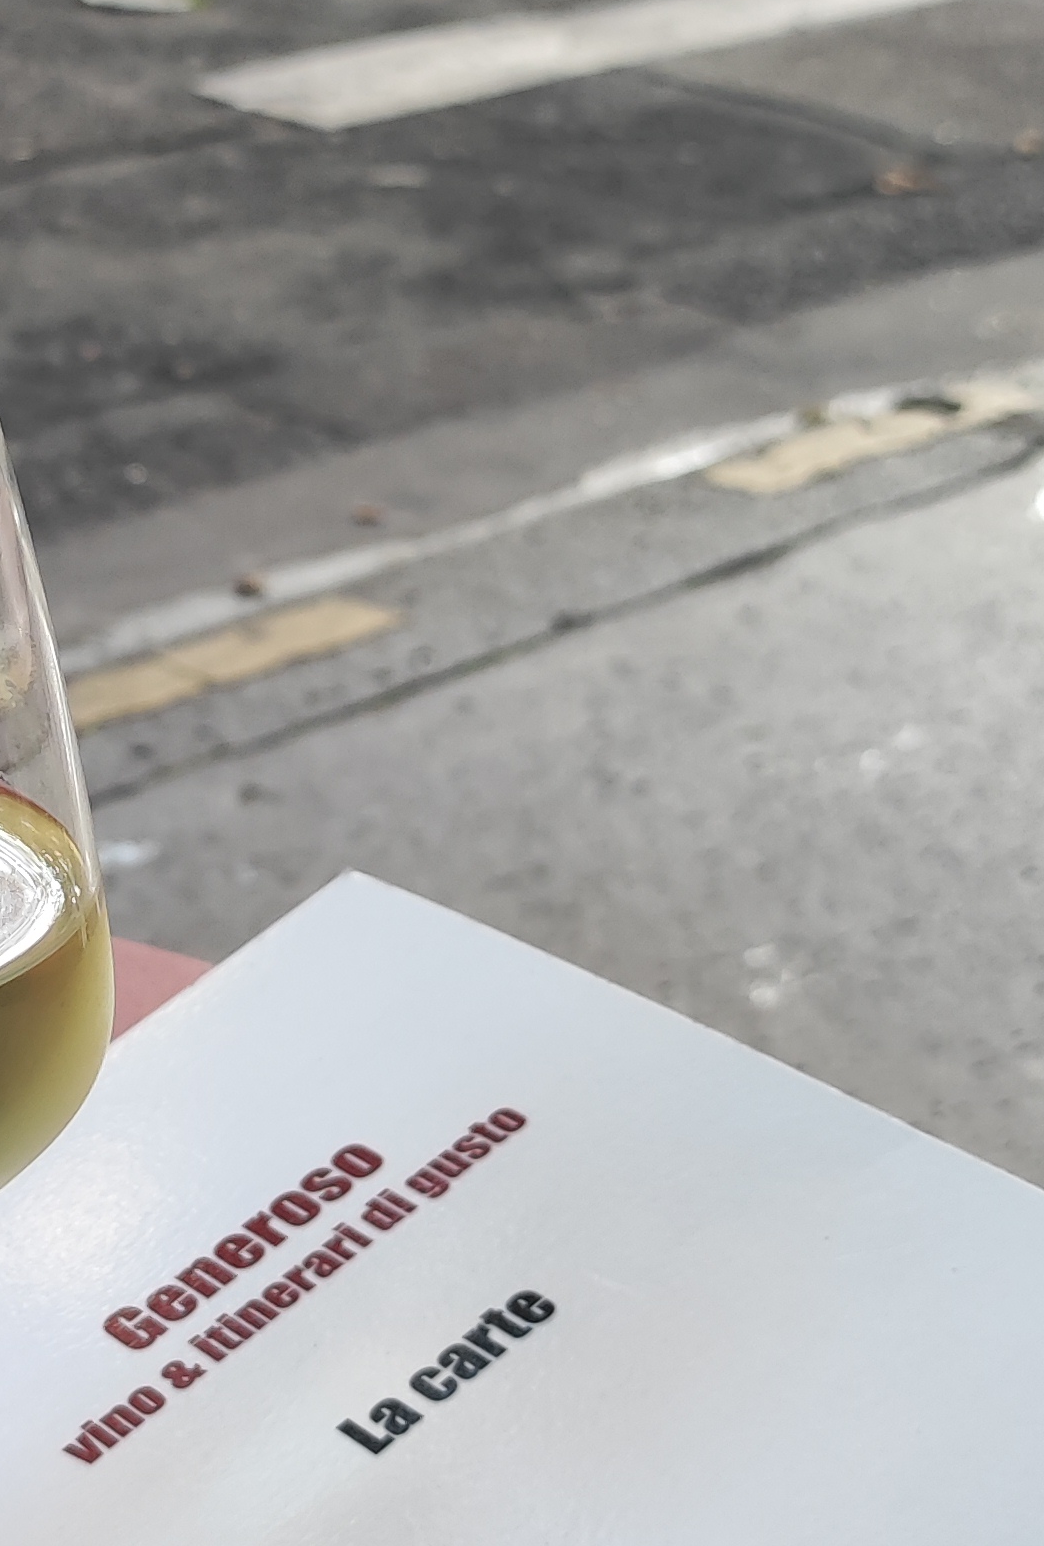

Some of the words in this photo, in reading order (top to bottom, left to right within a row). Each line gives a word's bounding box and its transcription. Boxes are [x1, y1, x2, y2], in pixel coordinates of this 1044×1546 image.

[62, 1385, 167, 1465] vino
[161, 1359, 207, 1390] &
[187, 1221, 374, 1363] itinerari
[360, 1188, 418, 1232] di
[405, 1107, 527, 1199] gusto
[102, 1143, 384, 1350] Generoso
[336, 1397, 424, 1455] La
[409, 1289, 556, 1402] carte
